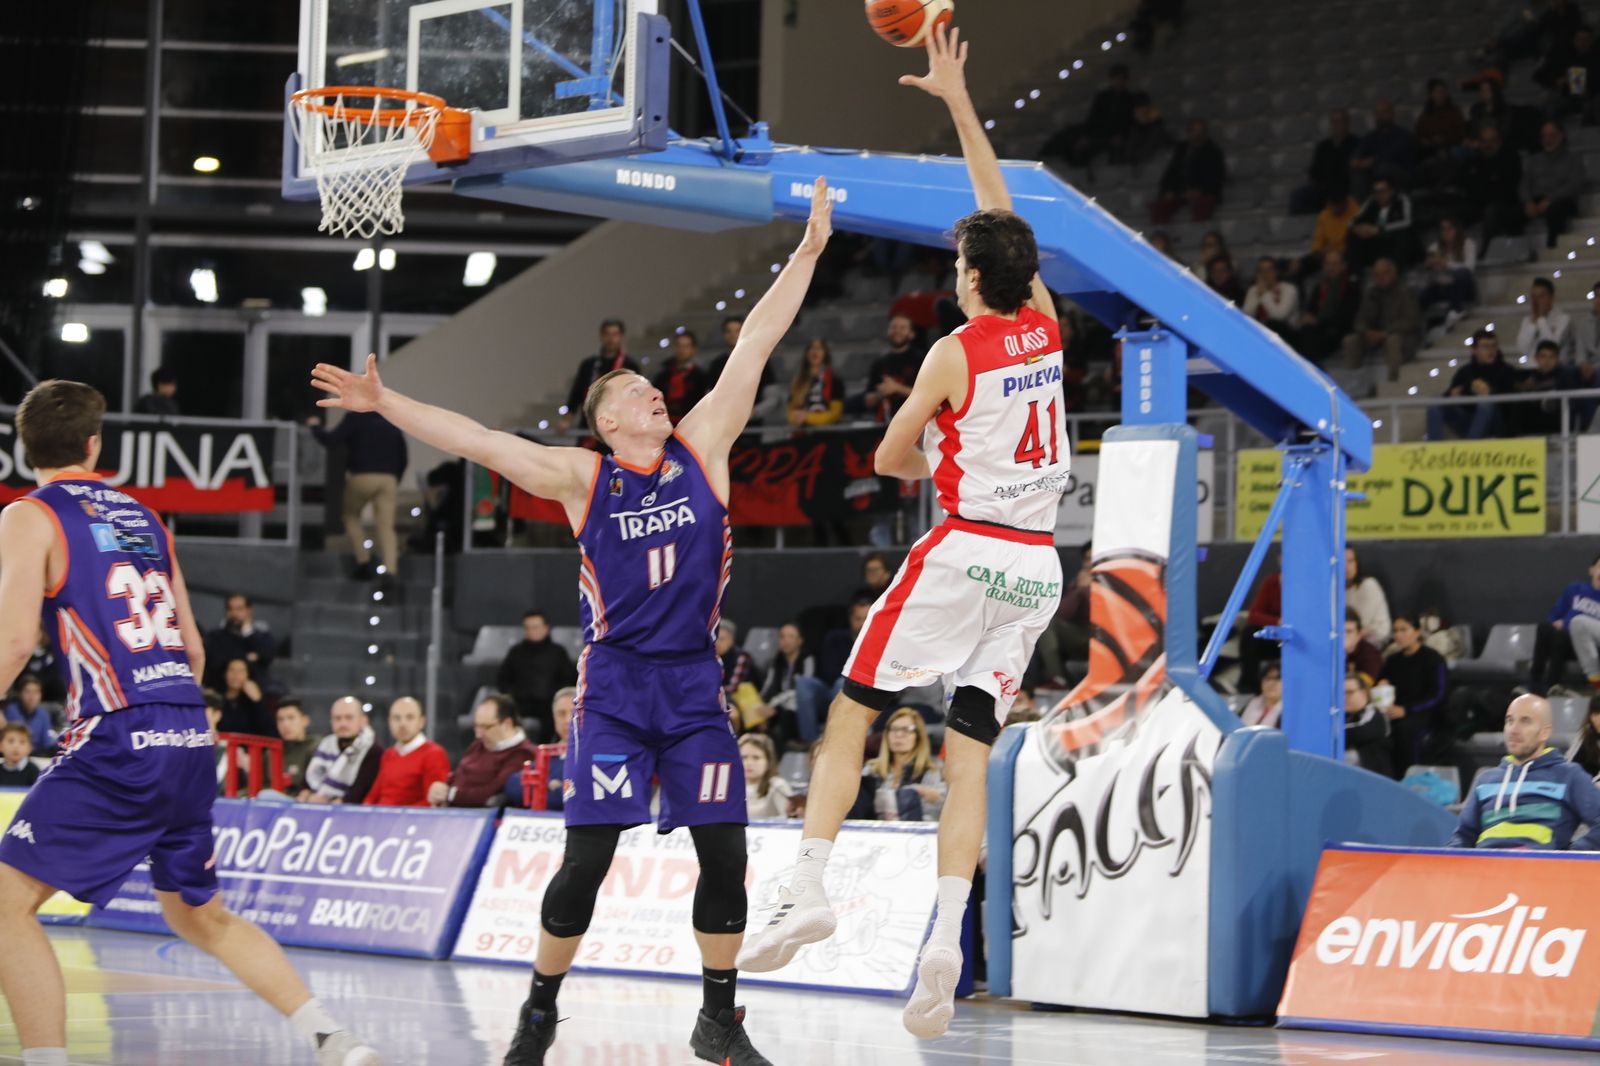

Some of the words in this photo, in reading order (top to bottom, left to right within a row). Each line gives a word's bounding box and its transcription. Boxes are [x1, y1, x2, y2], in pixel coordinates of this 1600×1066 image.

[616, 168, 676, 191] MONDO
[790, 182, 848, 203] MODO
[1003, 326, 1049, 357] OLMOS
[1003, 365, 1062, 398] PULEVA
[1140, 347, 1152, 415] MONDO
[1014, 395, 1059, 470] 41
[1402, 446, 1537, 471] Restaurante
[609, 496, 696, 541] TRAPA
[1402, 473, 1541, 531] DUKE
[648, 543, 677, 590] 11
[106, 562, 185, 652] 32
[985, 588, 1040, 610] GRANADA
[698, 762, 732, 803] 11
[617, 830, 641, 847] DE
[492, 848, 755, 900] MND
[475, 931, 535, 955] 979
[613, 942, 675, 966] 370
[1316, 893, 1587, 978] envialia
